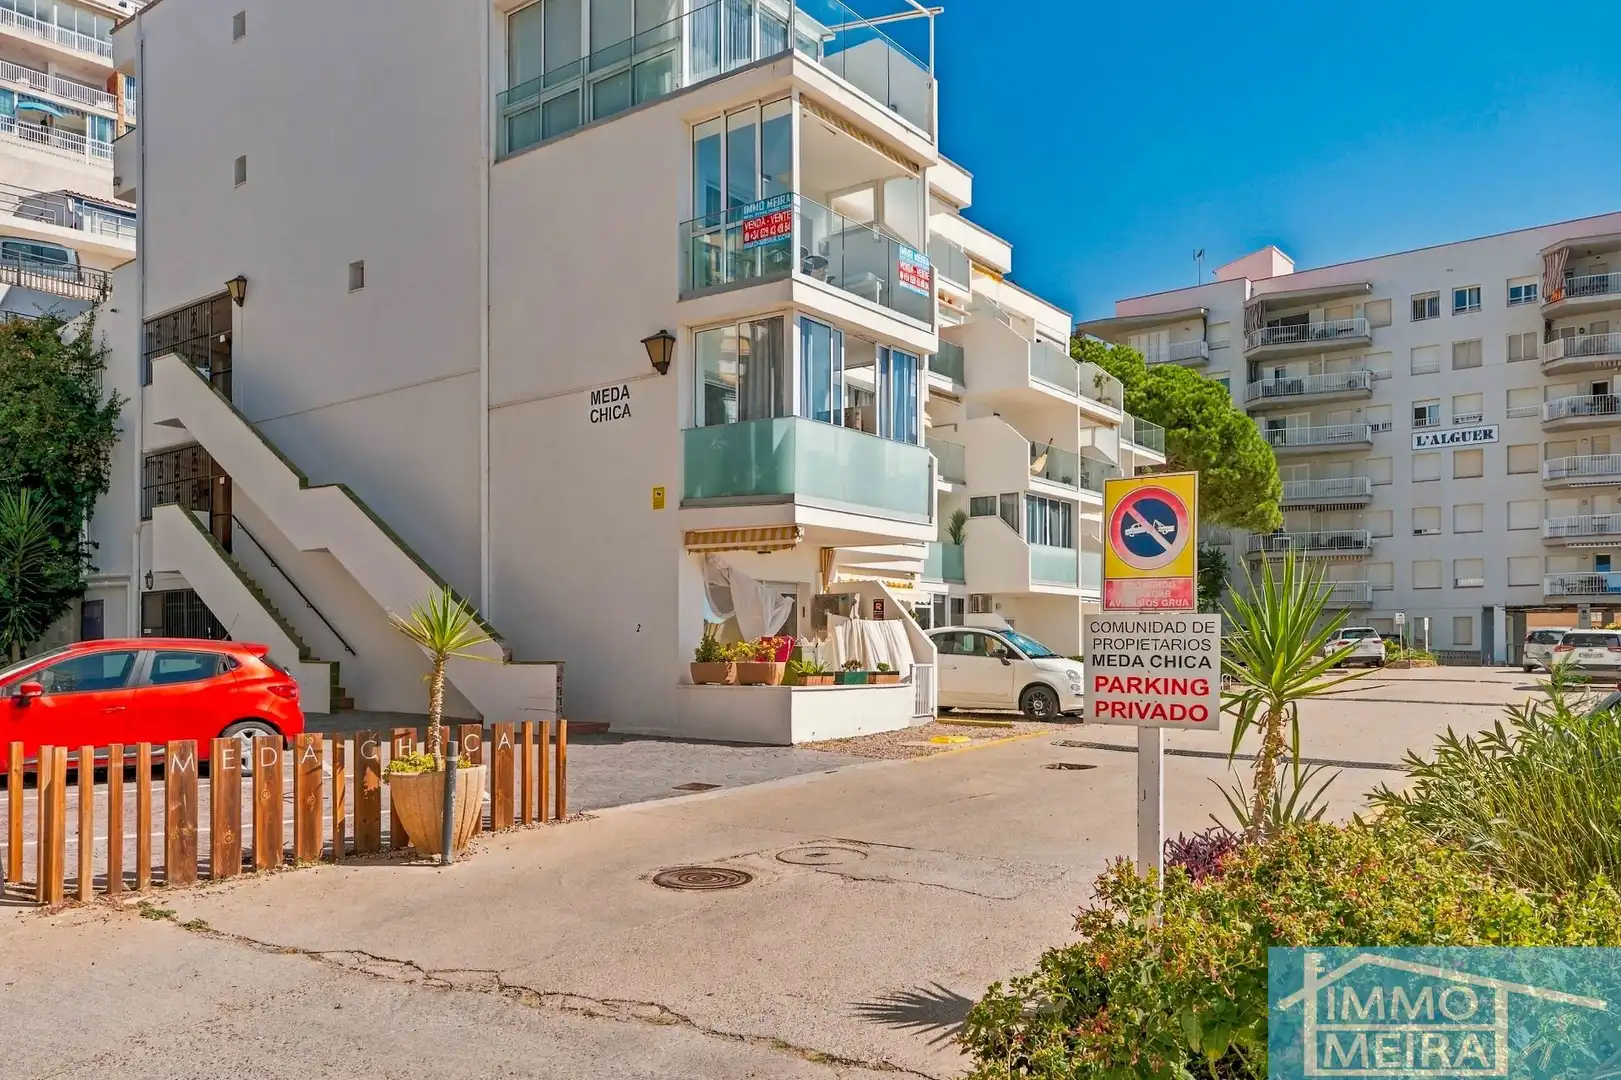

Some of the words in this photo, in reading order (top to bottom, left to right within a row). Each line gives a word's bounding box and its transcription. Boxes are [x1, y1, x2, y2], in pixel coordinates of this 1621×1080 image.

[743, 201, 765, 215] IMMO
[766, 194, 791, 209] MEIRA
[590, 384, 630, 406] MEDA
[590, 403, 631, 423] CHICA
[1416, 428, 1494, 447] L'ALGUER
[1161, 598, 1189, 607] GRUA
[1090, 621, 1186, 634] COMUNIDAD
[1192, 621, 1215, 634] DE
[1093, 638, 1211, 651] PROPIETARIOS
[1092, 654, 1144, 668] MEDA
[1150, 655, 1212, 669] CHICA
[1095, 675, 1210, 696] PARKING
[1095, 700, 1208, 722] PRIVADO
[361, 732, 512, 760] CHCA
